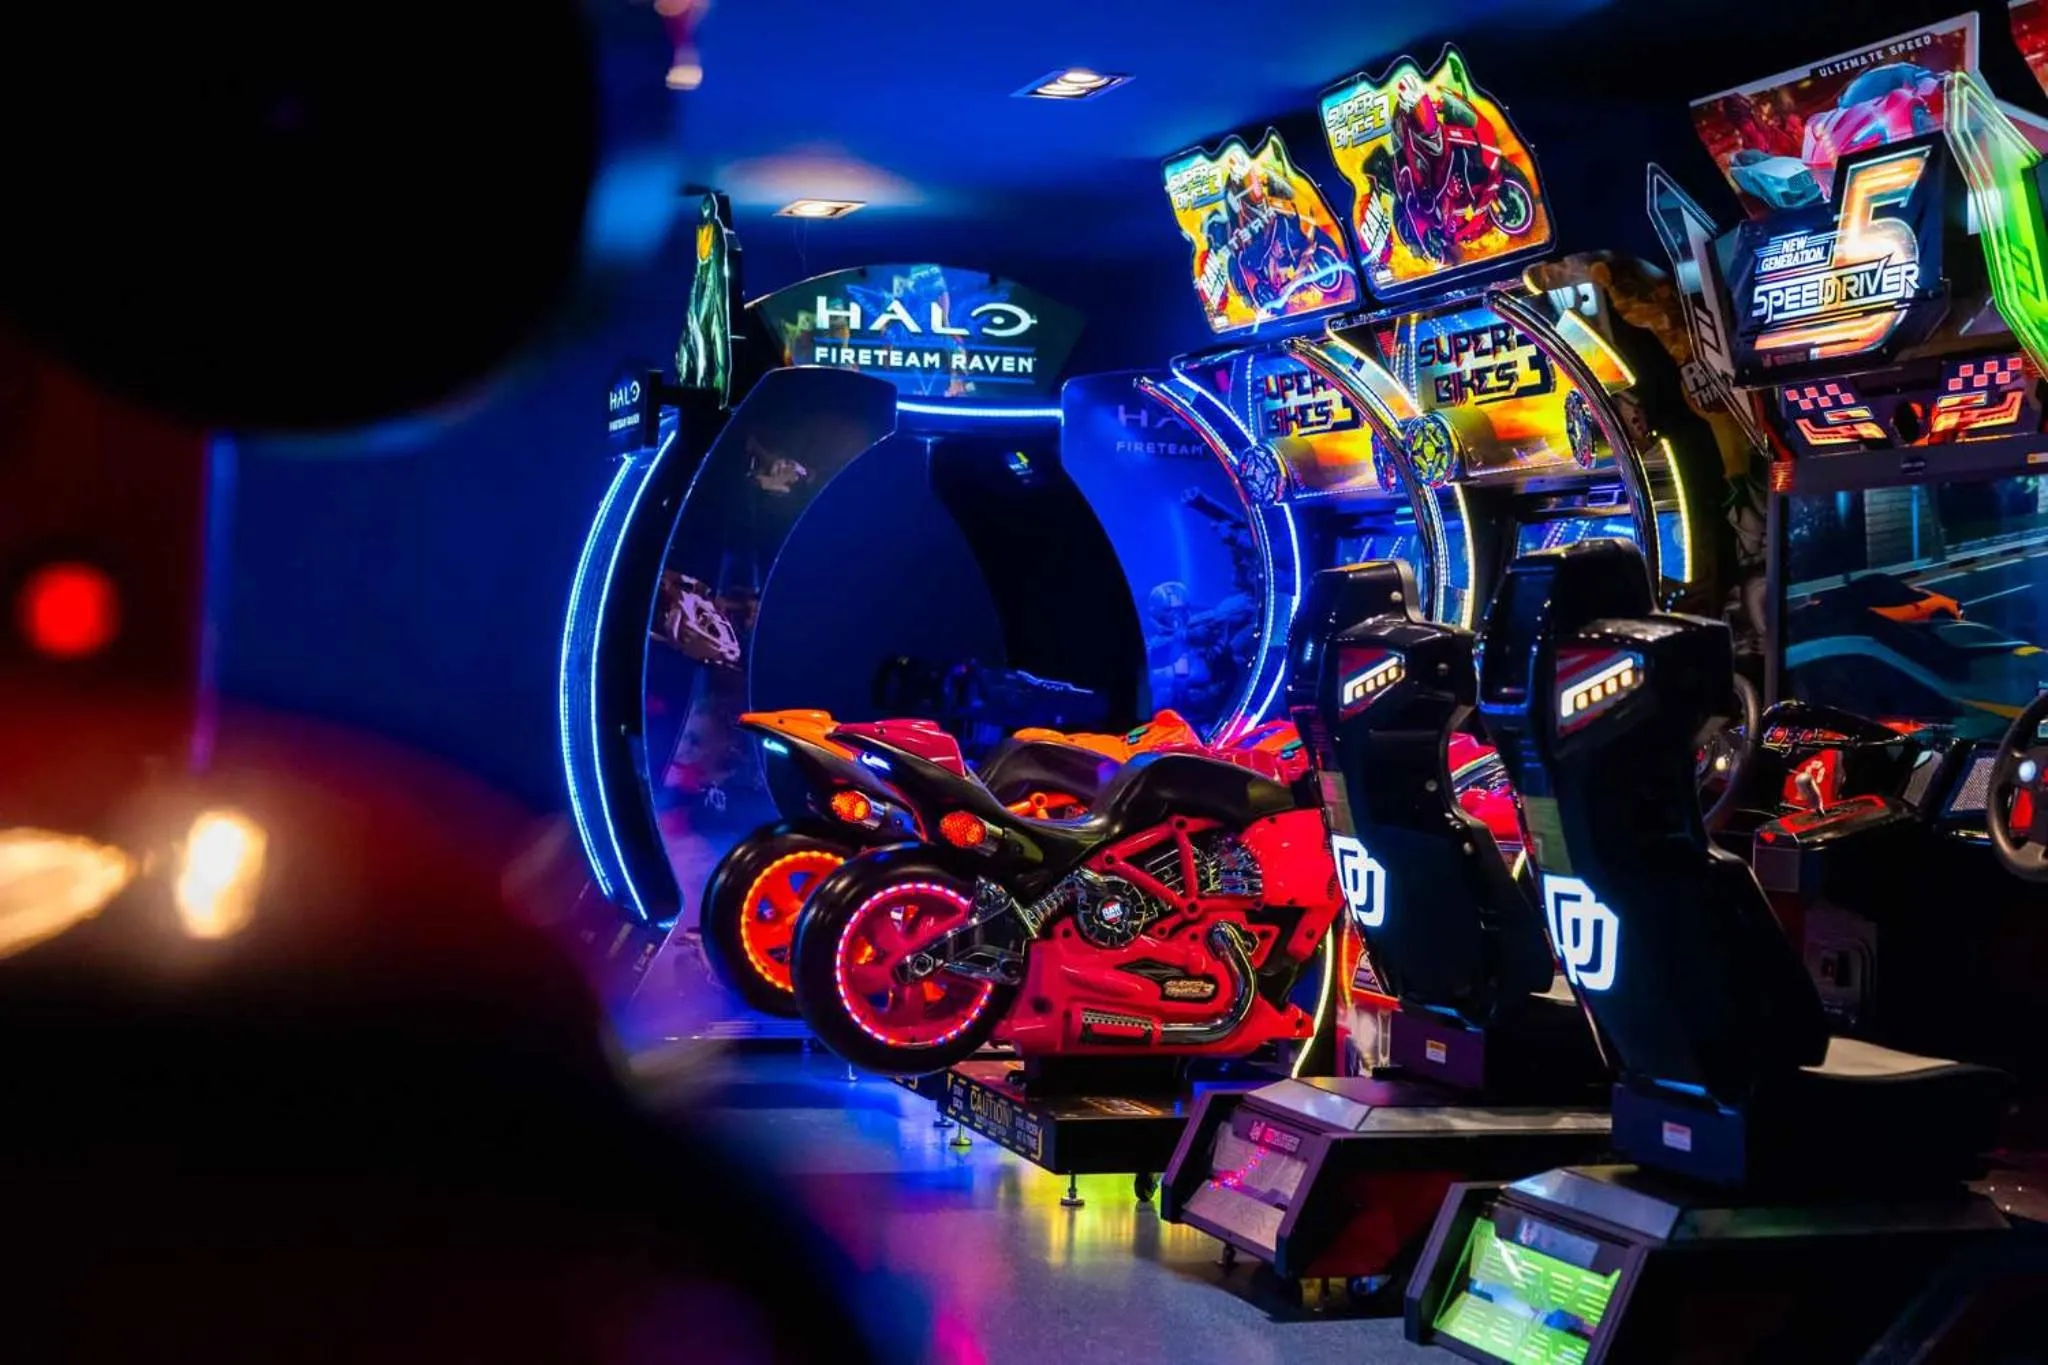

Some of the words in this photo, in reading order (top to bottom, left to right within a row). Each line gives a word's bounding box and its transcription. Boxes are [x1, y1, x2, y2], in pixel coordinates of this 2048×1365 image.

[1819, 49, 1884, 77] ULTIMATE
[1889, 35, 1932, 56] SPEED
[1326, 92, 1376, 129] SUPER
[1761, 246, 1827, 272] GENERATION
[1782, 235, 1808, 254] NEW
[815, 295, 1038, 337] HALO
[1419, 321, 1516, 368] SUPER
[815, 347, 940, 369] FIRETEAM
[951, 353, 1034, 374] RAVEN
[609, 380, 641, 412] HALO
[1118, 404, 1192, 433] HA
[1116, 441, 1204, 456] FIRETEAM
